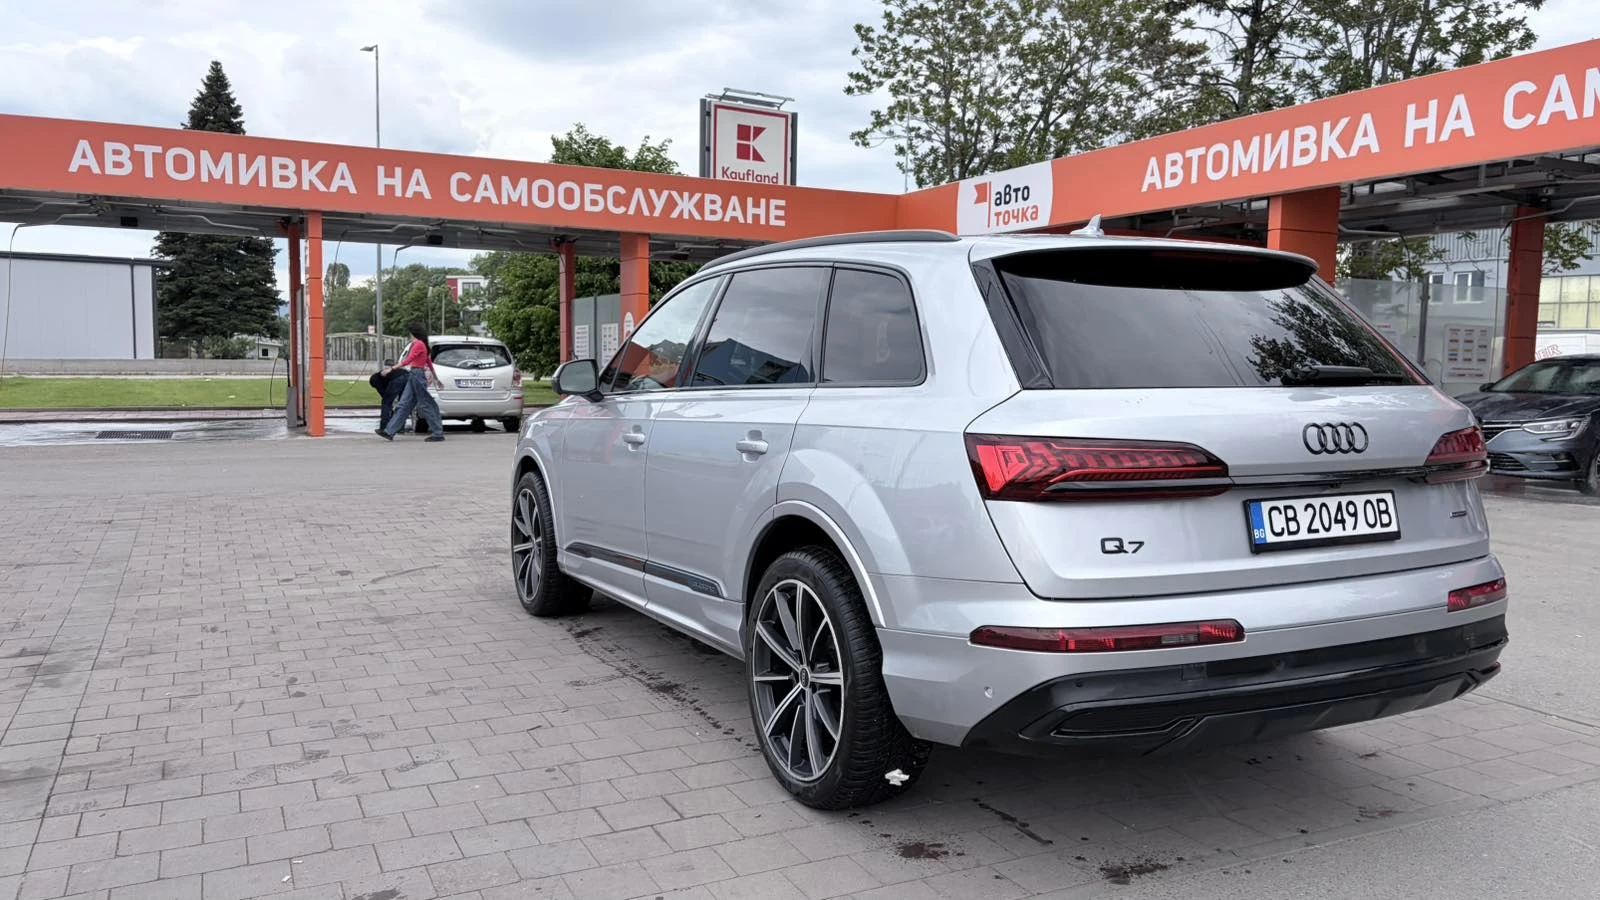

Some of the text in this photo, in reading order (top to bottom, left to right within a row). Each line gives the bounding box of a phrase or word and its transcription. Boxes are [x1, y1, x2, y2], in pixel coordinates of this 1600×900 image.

[1141, 112, 1380, 193] АВТОМИВКА
[1404, 94, 1476, 148] НА
[68, 139, 786, 227] АВТОМИВКА НА САМООБСЛУЖВАНЕ
[721, 166, 779, 184] Kaufland
[994, 184, 1030, 207] авто
[994, 205, 1039, 227] точка
[1268, 505, 1300, 537] CB
[1304, 501, 1358, 534] 2049
[1254, 528, 1265, 539] BG
[1101, 537, 1144, 554] Q7
